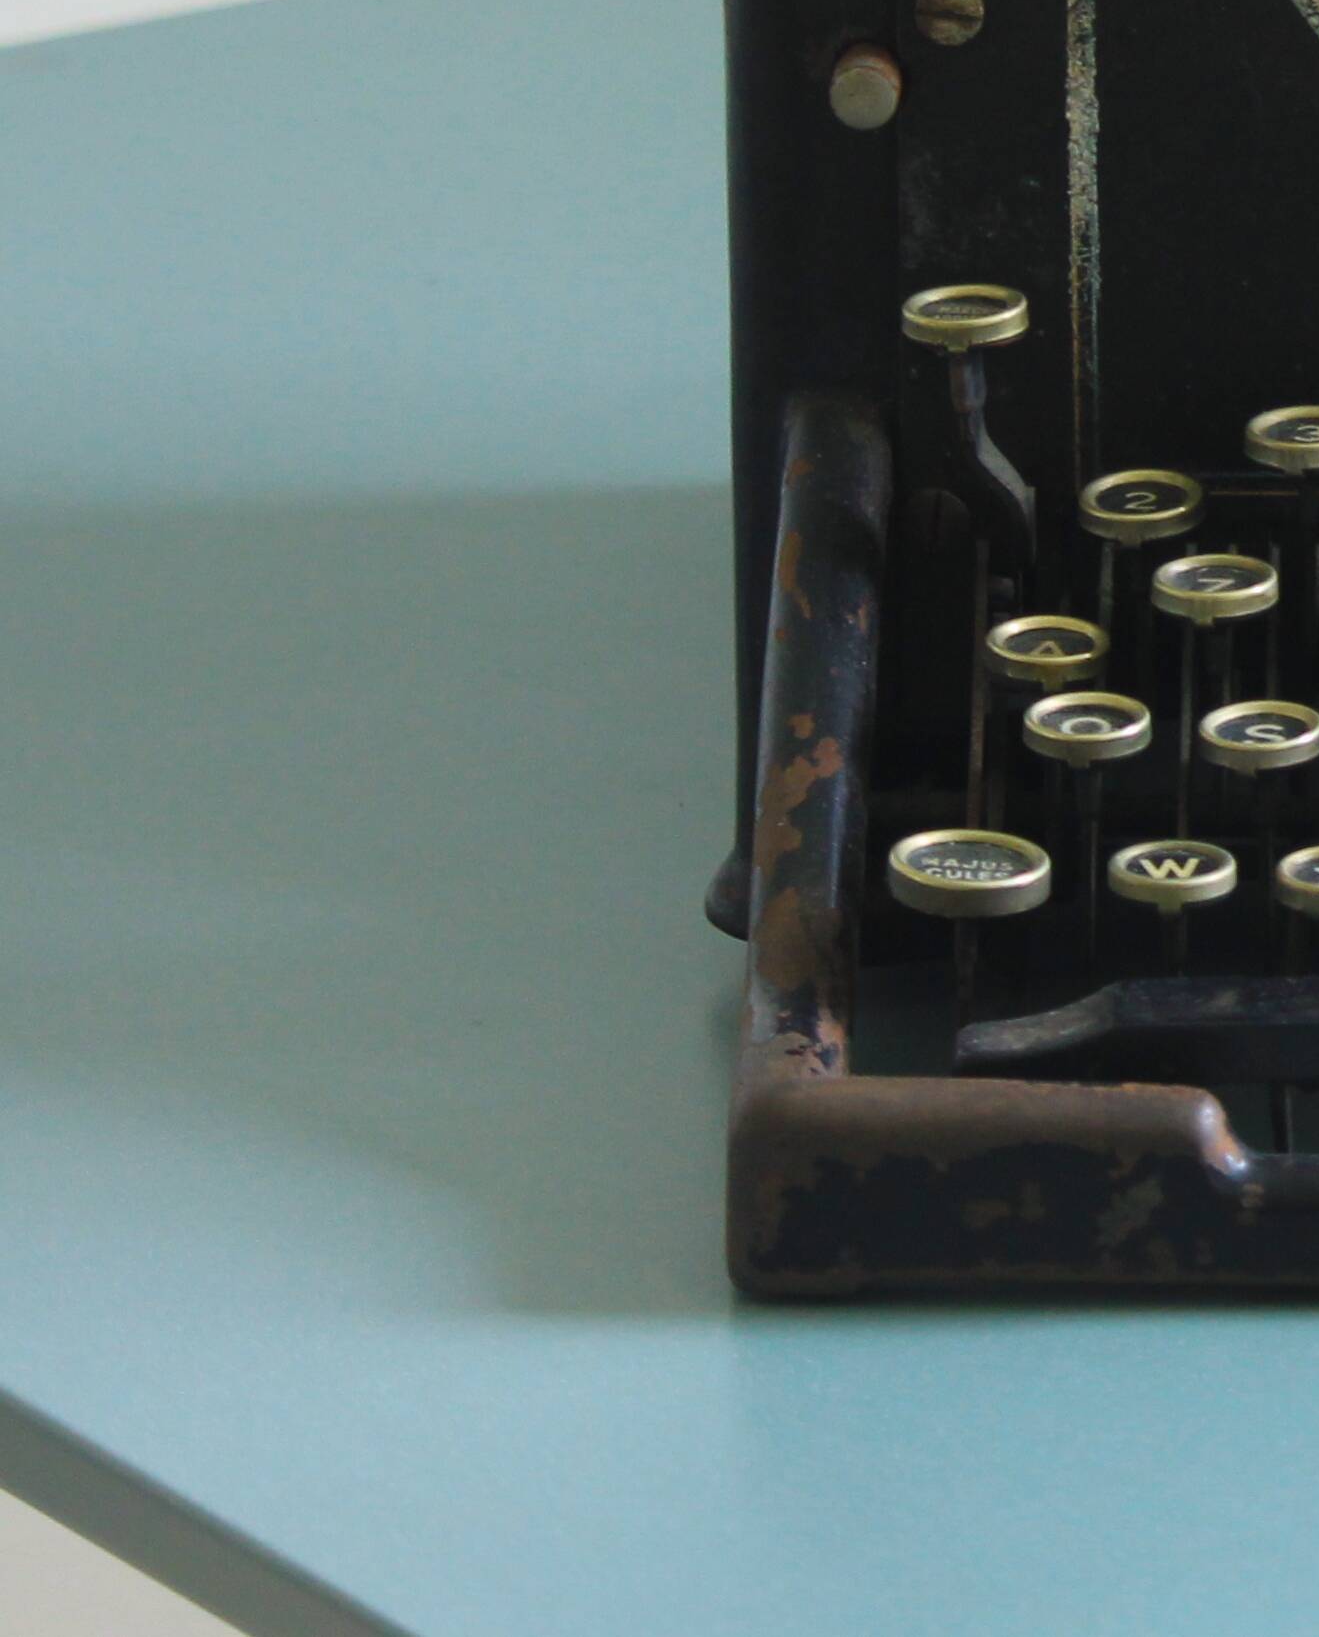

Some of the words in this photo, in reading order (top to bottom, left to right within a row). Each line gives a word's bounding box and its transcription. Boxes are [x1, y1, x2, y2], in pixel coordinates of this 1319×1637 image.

[1124, 492, 1156, 511] 2
[1028, 640, 1066, 656] A
[1245, 724, 1286, 742] S
[1139, 857, 1202, 880] W
